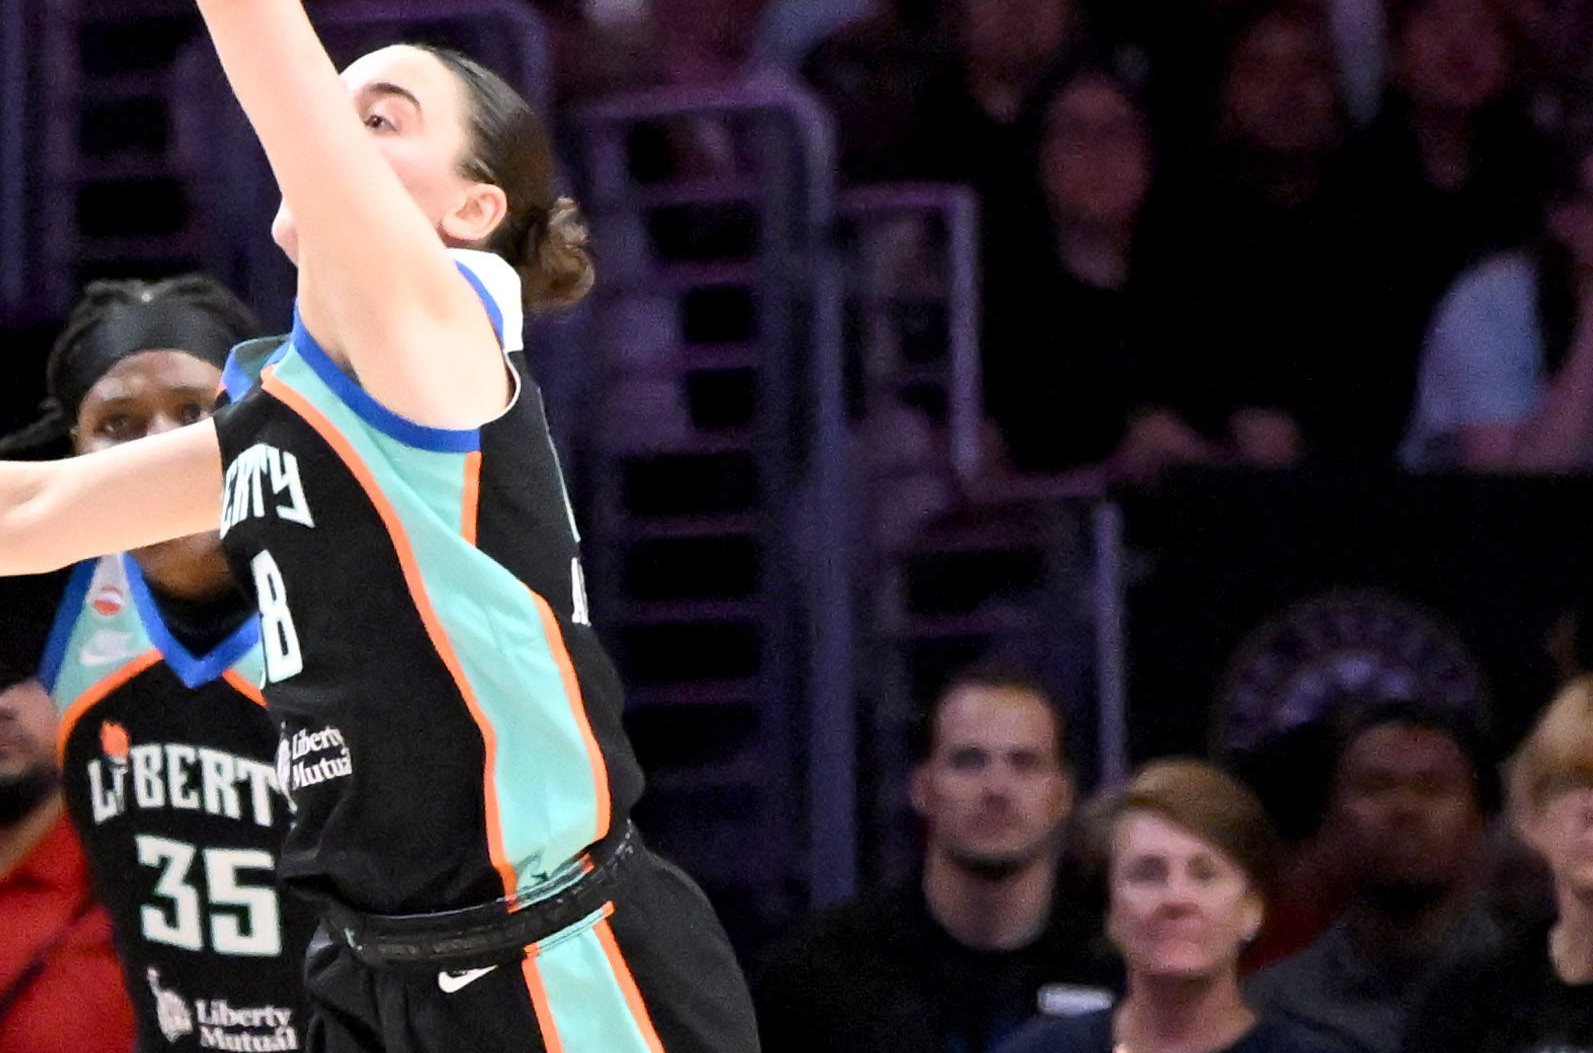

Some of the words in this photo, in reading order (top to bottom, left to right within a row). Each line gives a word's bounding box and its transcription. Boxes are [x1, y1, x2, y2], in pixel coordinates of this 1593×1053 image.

[251, 549, 303, 686] 8
[87, 721, 298, 828] LIBERT
[135, 835, 282, 957] 35
[195, 1000, 291, 1028] Liberty
[200, 1026, 298, 1052] Mutual
